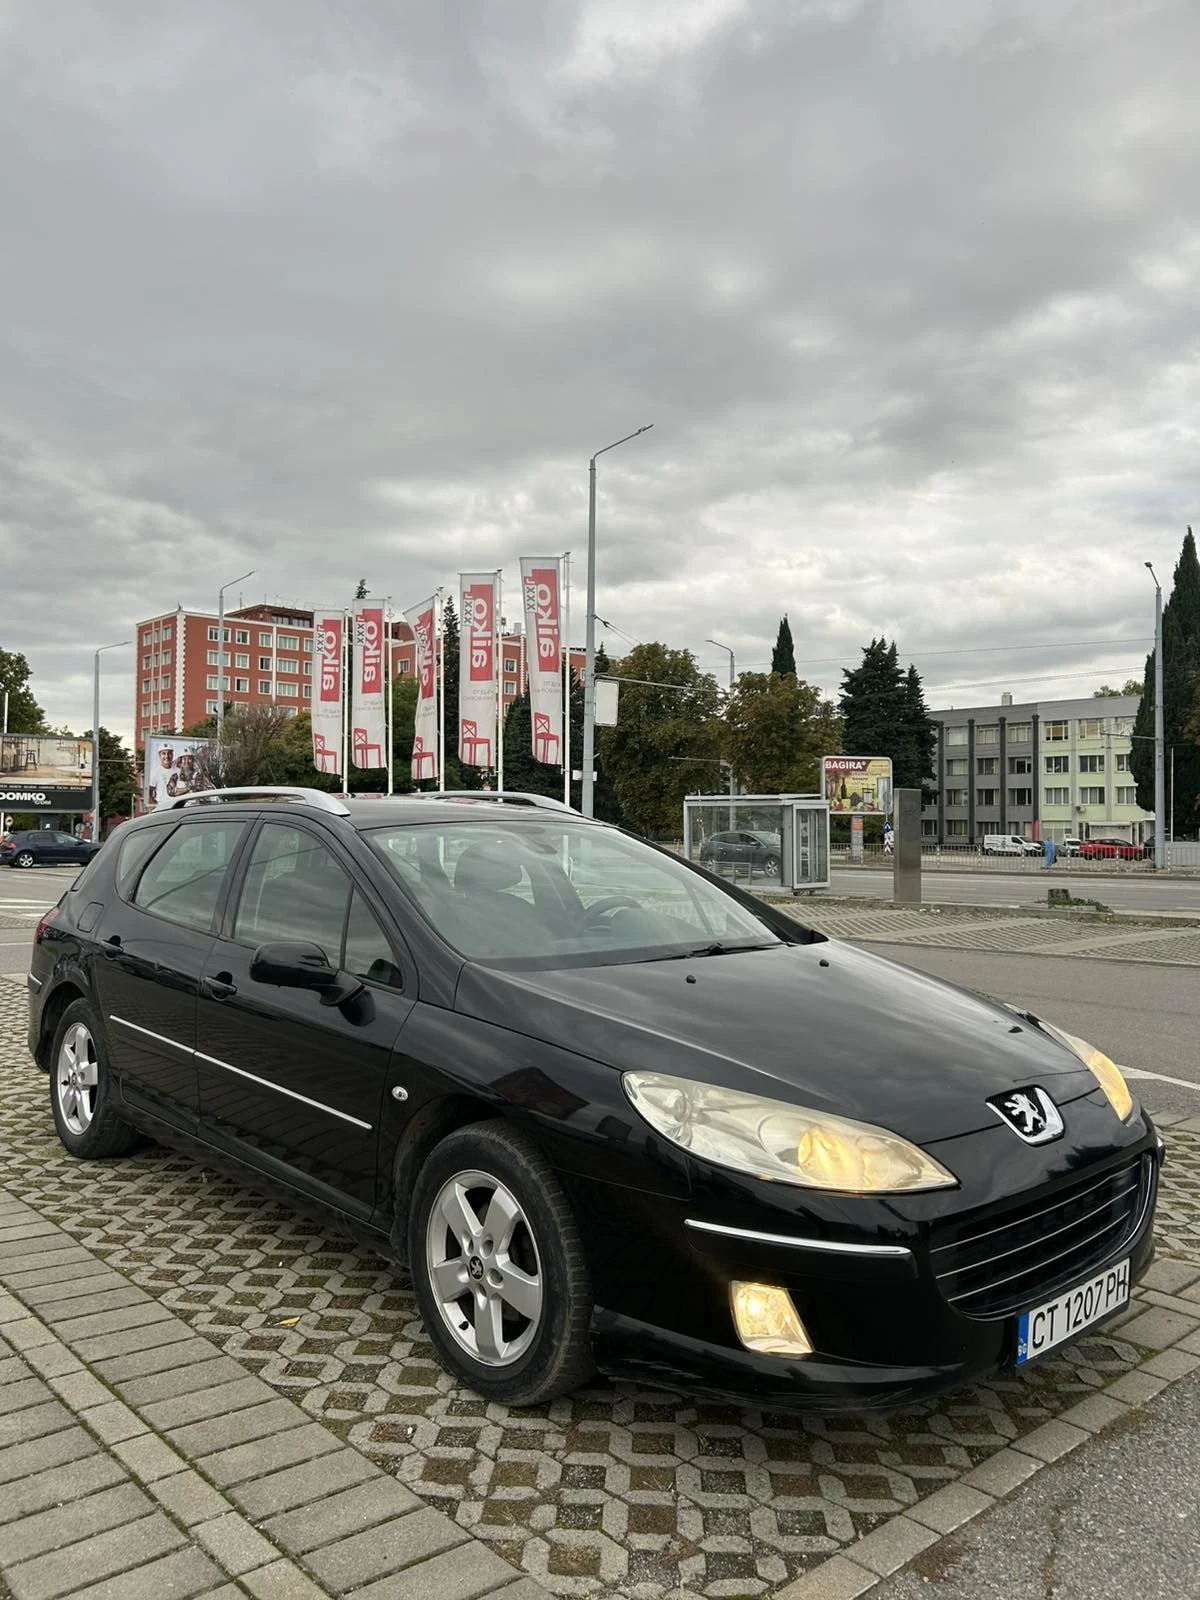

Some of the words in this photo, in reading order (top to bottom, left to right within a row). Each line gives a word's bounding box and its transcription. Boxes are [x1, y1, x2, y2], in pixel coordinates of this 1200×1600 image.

[1032, 1304, 1059, 1349] CT
[1064, 1279, 1104, 1333] 1207
[1105, 1264, 1128, 1308] PH
